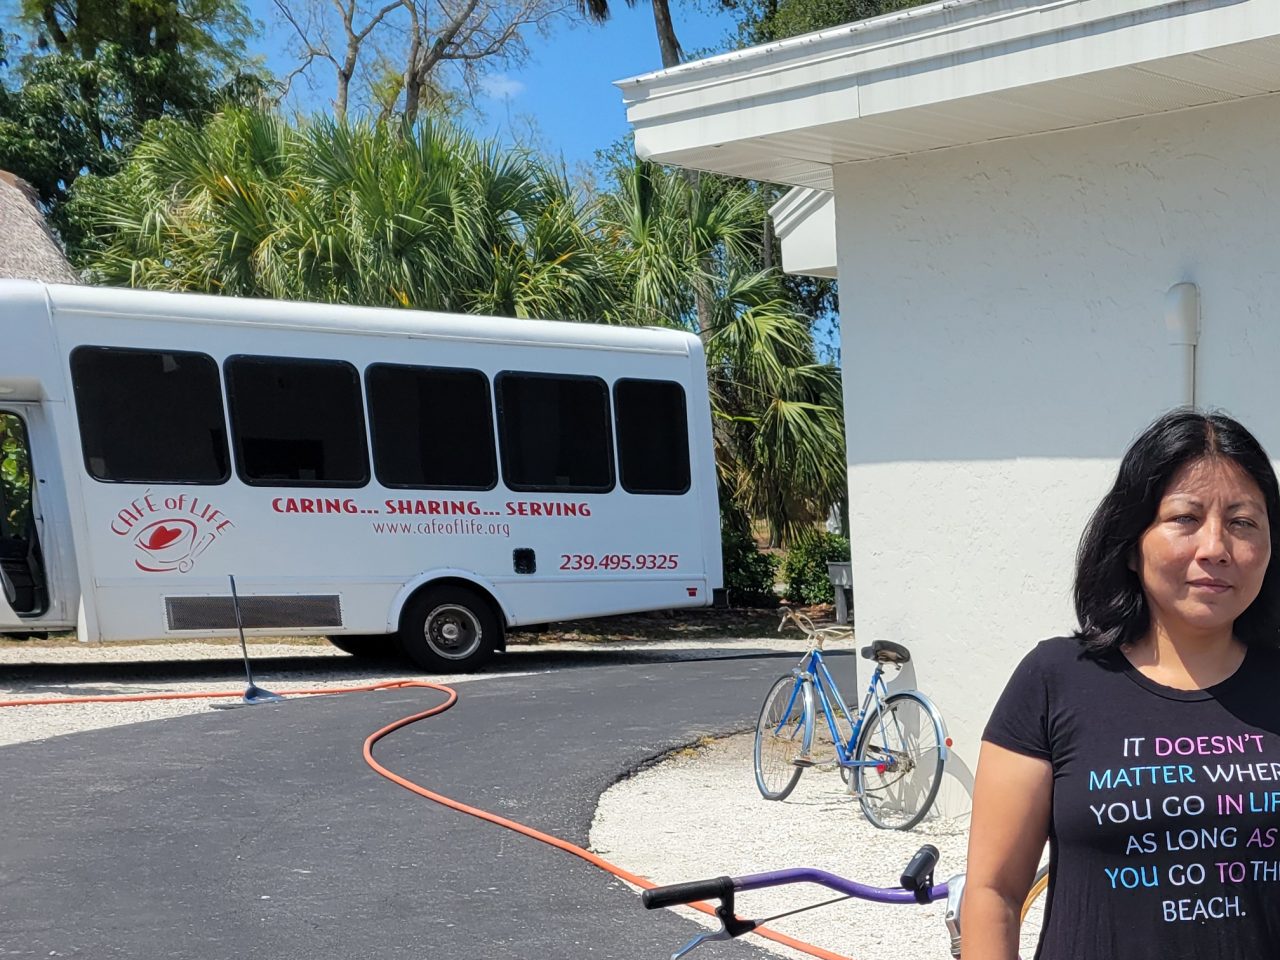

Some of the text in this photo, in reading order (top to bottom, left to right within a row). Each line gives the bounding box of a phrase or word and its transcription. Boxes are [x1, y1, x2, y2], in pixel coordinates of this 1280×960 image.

[111, 488, 236, 536] CAFÉ of LIFE
[271, 497, 591, 517] CARING... SHARING... SERVING
[372, 518, 510, 538] www.cafeoflife.org
[559, 554, 679, 570] 239.495.9325
[1123, 734, 1264, 757] IT DOESN'T
[1089, 764, 1196, 791] MATTER
[1089, 798, 1152, 825] YOU
[1162, 795, 1205, 817] GO
[1217, 794, 1243, 815] IN
[1125, 826, 1279, 855] AS LONG AS
[1104, 865, 1159, 889] YOU
[1168, 863, 1206, 886] GO
[1214, 861, 1246, 883] TO
[1162, 895, 1246, 922] BEACH.
